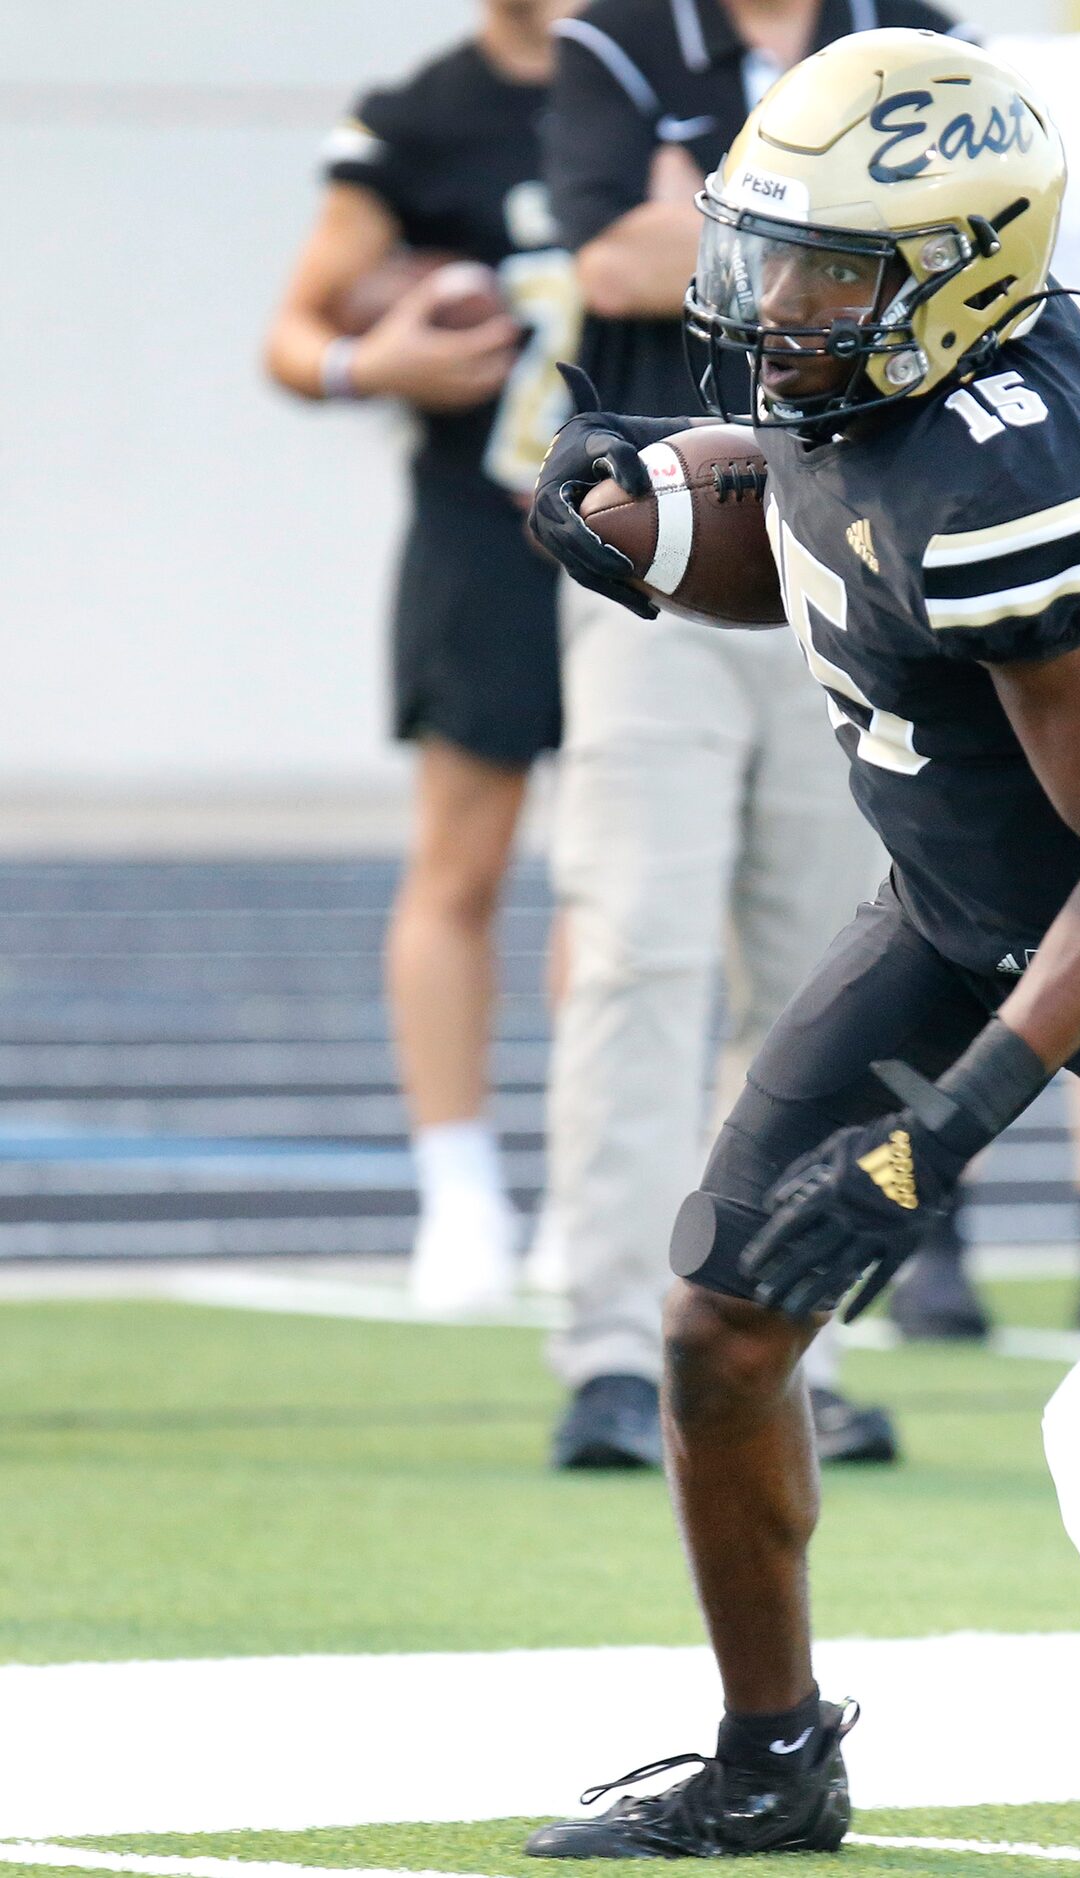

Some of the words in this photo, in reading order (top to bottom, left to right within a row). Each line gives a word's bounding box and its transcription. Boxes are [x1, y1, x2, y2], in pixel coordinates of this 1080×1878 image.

[868, 90, 1035, 183] East
[741, 172, 788, 201] PESH
[943, 370, 1050, 445] 15
